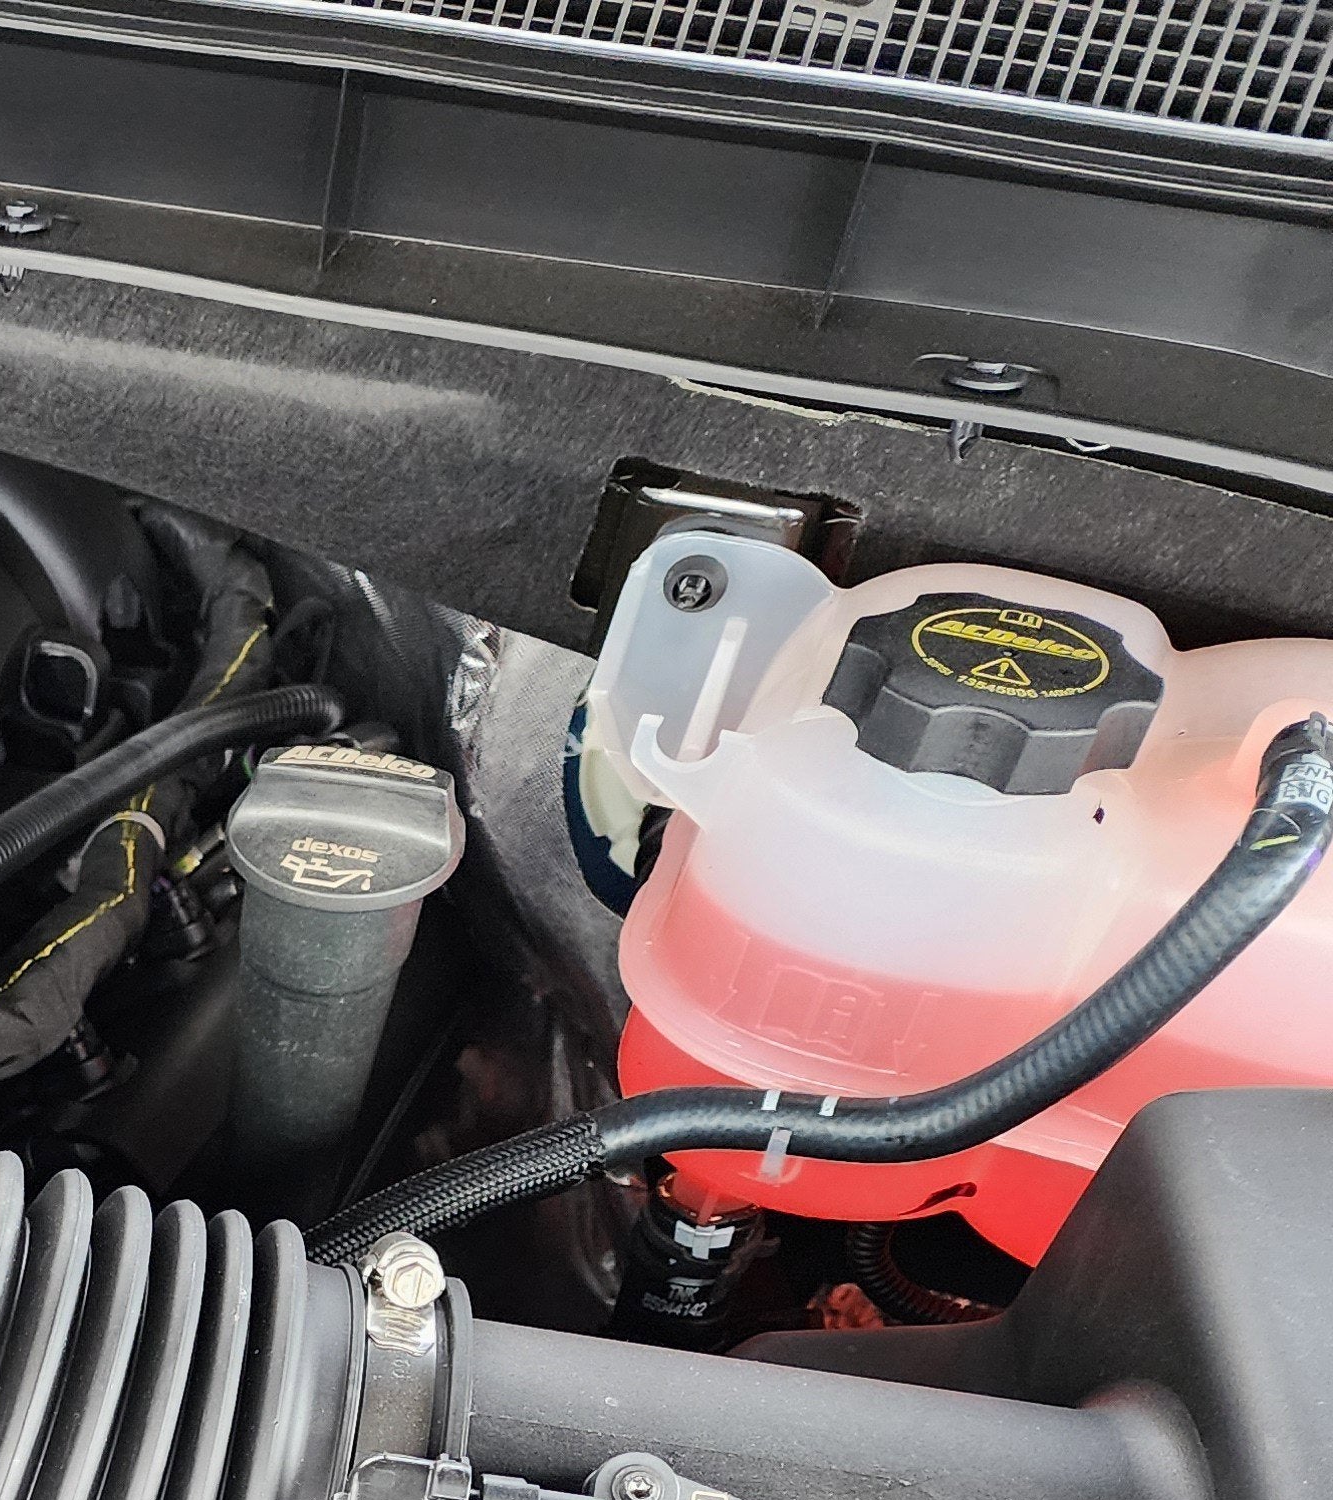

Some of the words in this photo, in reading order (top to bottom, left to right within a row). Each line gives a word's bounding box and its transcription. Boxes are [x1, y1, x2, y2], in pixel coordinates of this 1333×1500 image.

[924, 619, 1100, 661] ACDelco
[274, 745, 437, 779] ACDelco
[291, 837, 383, 863] dexos
